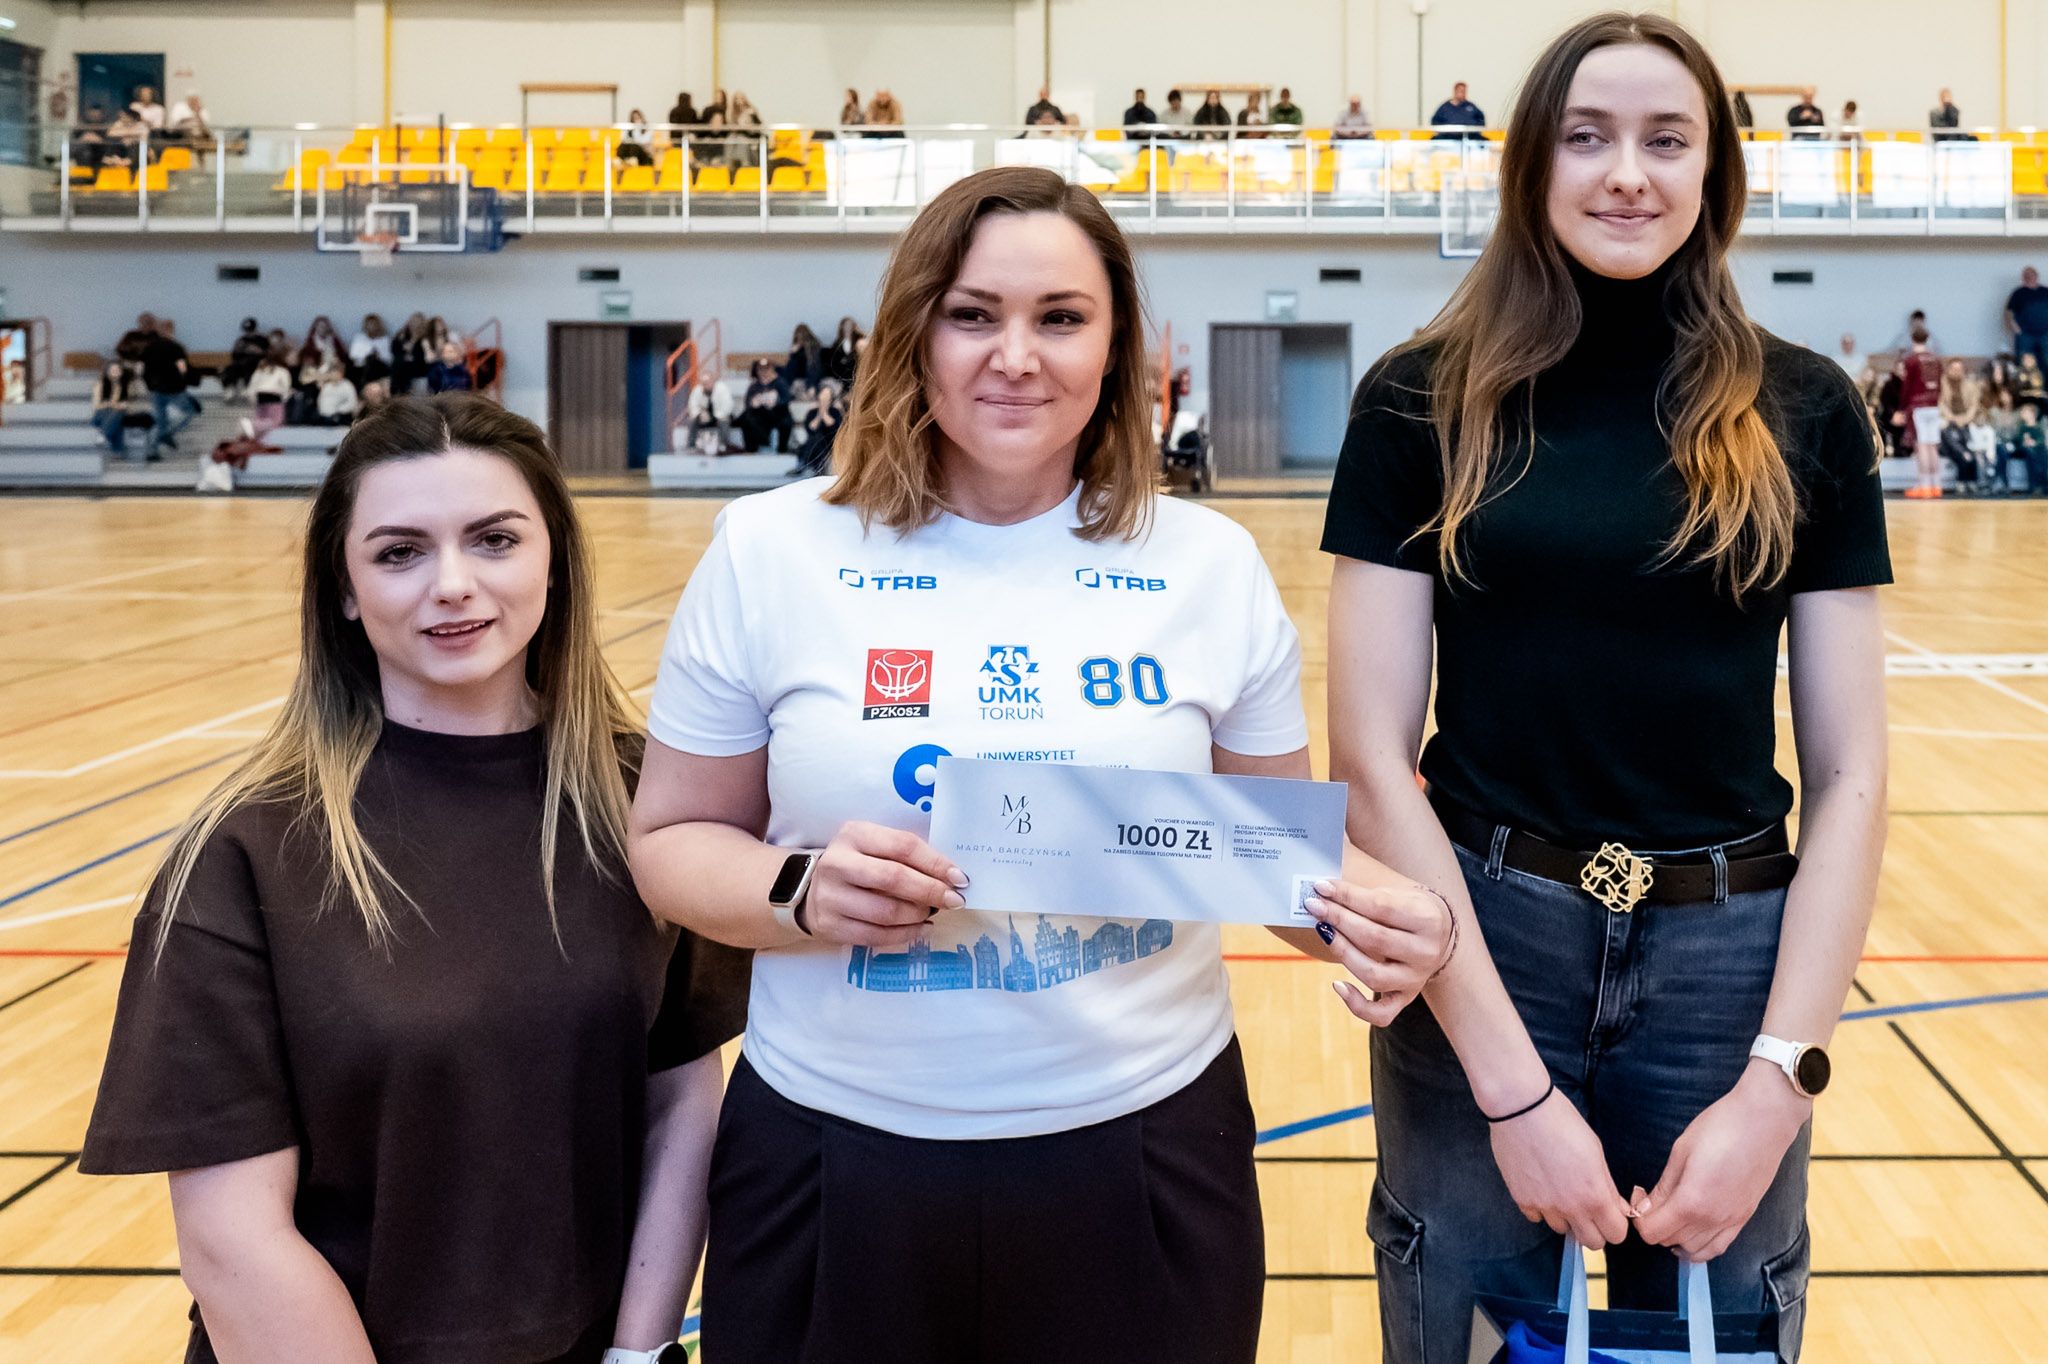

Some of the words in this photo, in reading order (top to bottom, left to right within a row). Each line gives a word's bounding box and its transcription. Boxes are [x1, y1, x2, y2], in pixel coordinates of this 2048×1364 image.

[871, 575, 937, 591] TRB
[1106, 574, 1167, 591] TRB
[1077, 652, 1173, 709] 80
[978, 687, 1042, 703] UMK
[978, 704, 1044, 720] TORUŃ
[976, 750, 1076, 761] UNIWERSYTET
[1117, 824, 1178, 848] 1000
[1185, 829, 1213, 851] ZŁ
[956, 844, 993, 852] MARTA
[998, 846, 1072, 857] BARCZYŃSKA
